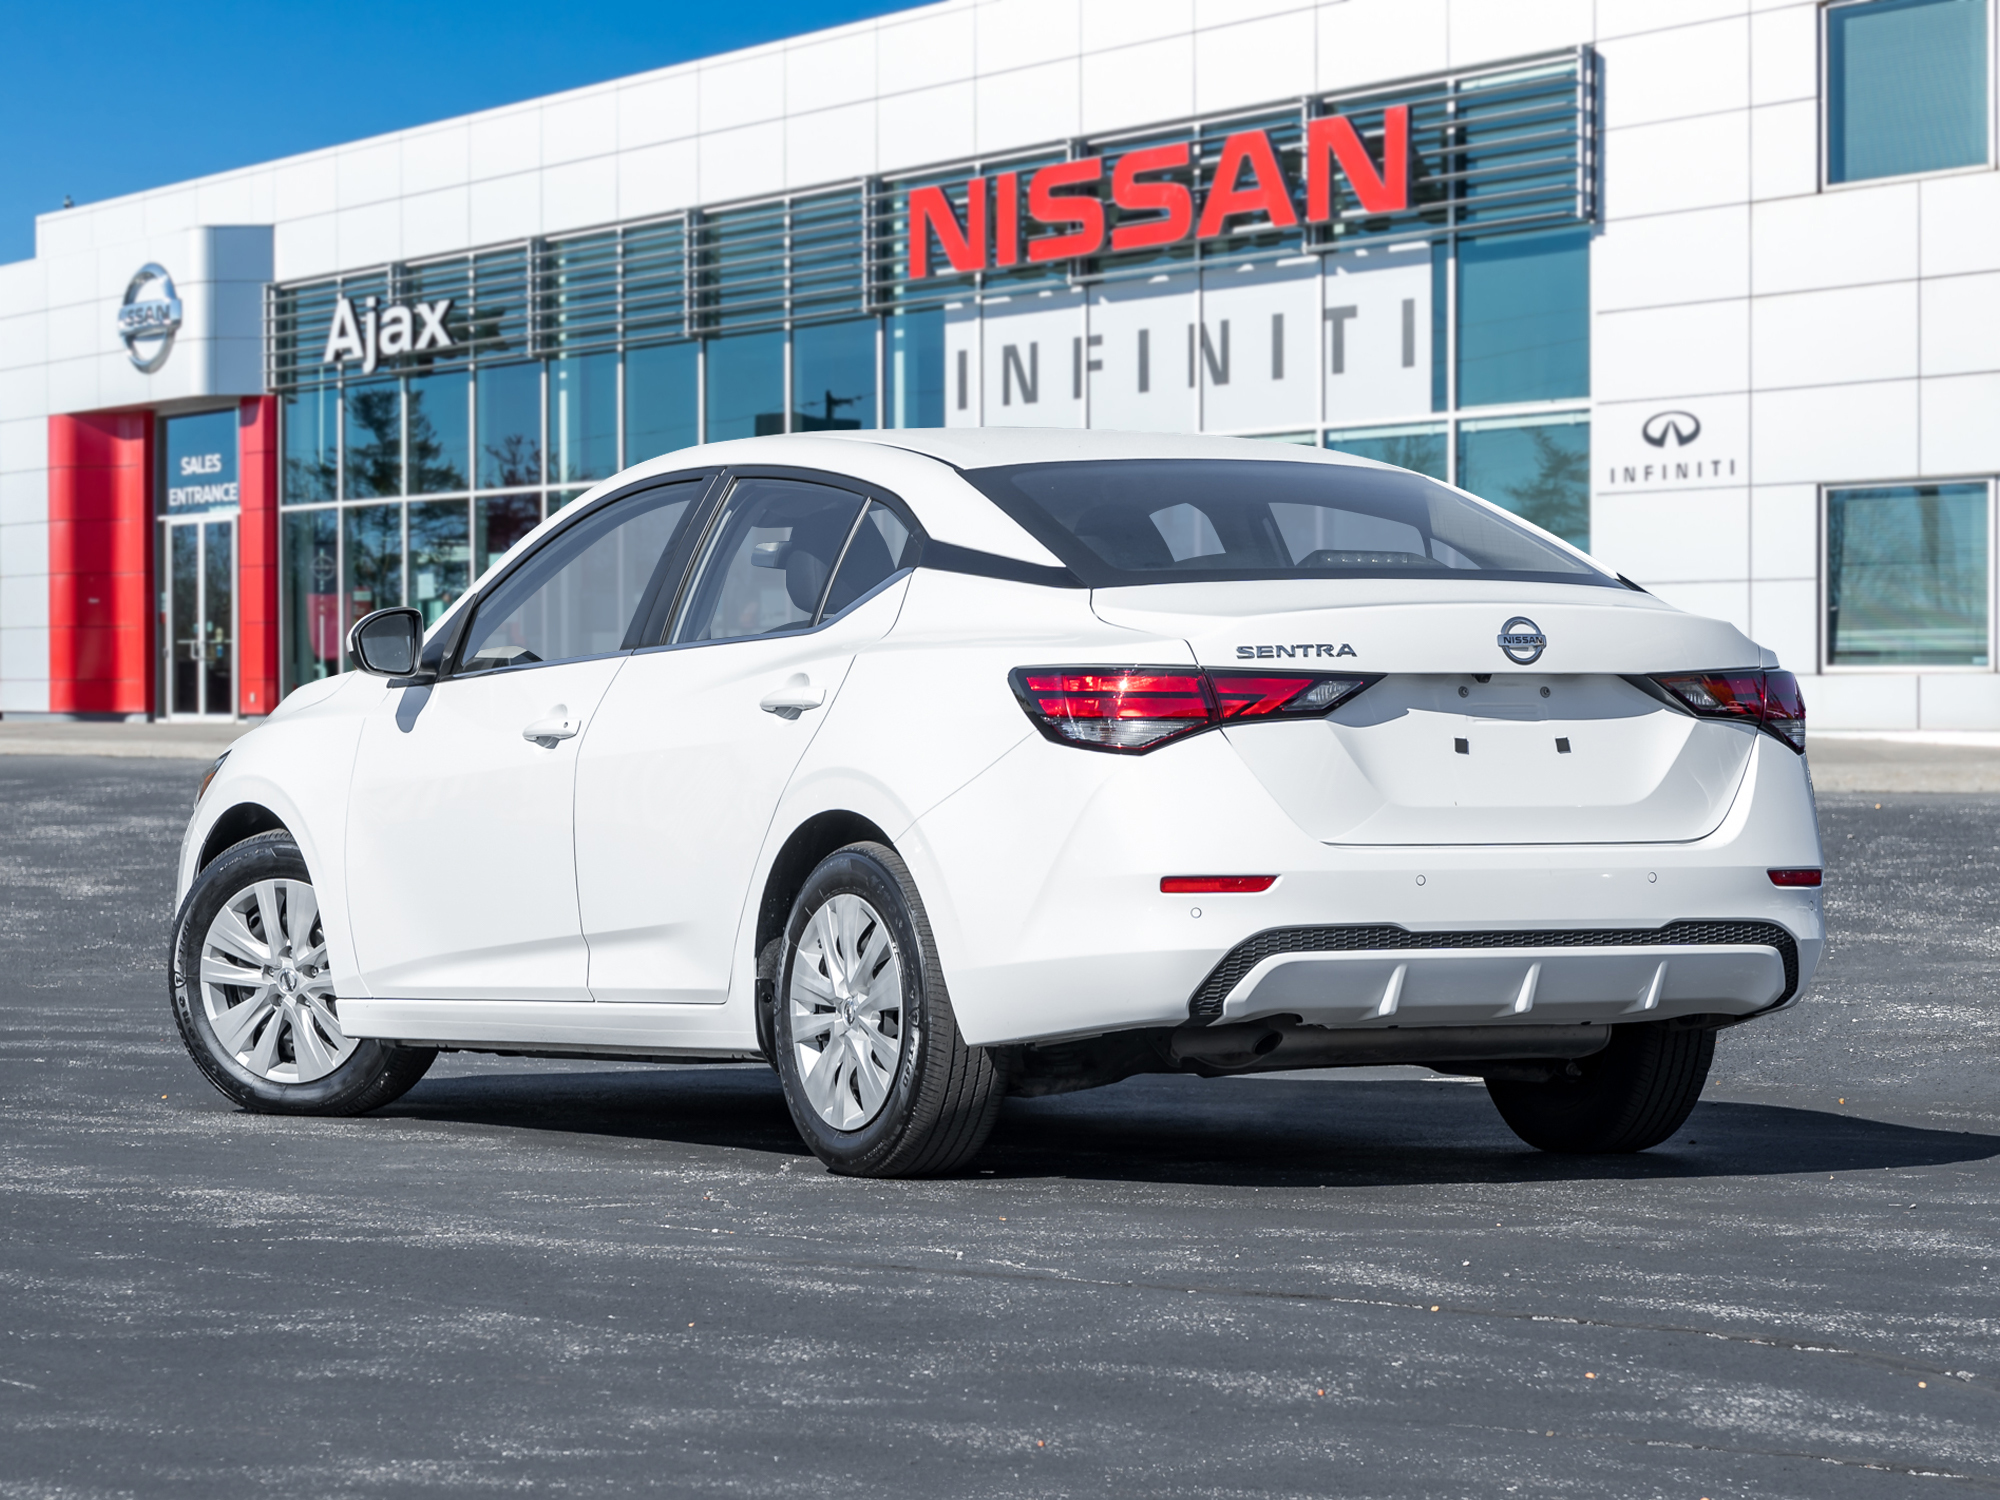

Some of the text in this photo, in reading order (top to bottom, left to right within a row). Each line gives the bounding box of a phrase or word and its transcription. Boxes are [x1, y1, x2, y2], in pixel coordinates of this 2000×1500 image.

[908, 104, 1410, 280] NISSAN
[124, 304, 171, 327] SSAN
[323, 296, 453, 375] Ajax
[957, 298, 1416, 411] INFINITI
[181, 453, 222, 476] SALES
[1610, 458, 1735, 484] INFINITI
[168, 482, 239, 506] ENTRANCE
[1236, 643, 1357, 659] SENTRA
[1503, 636, 1543, 644] NISSAN
